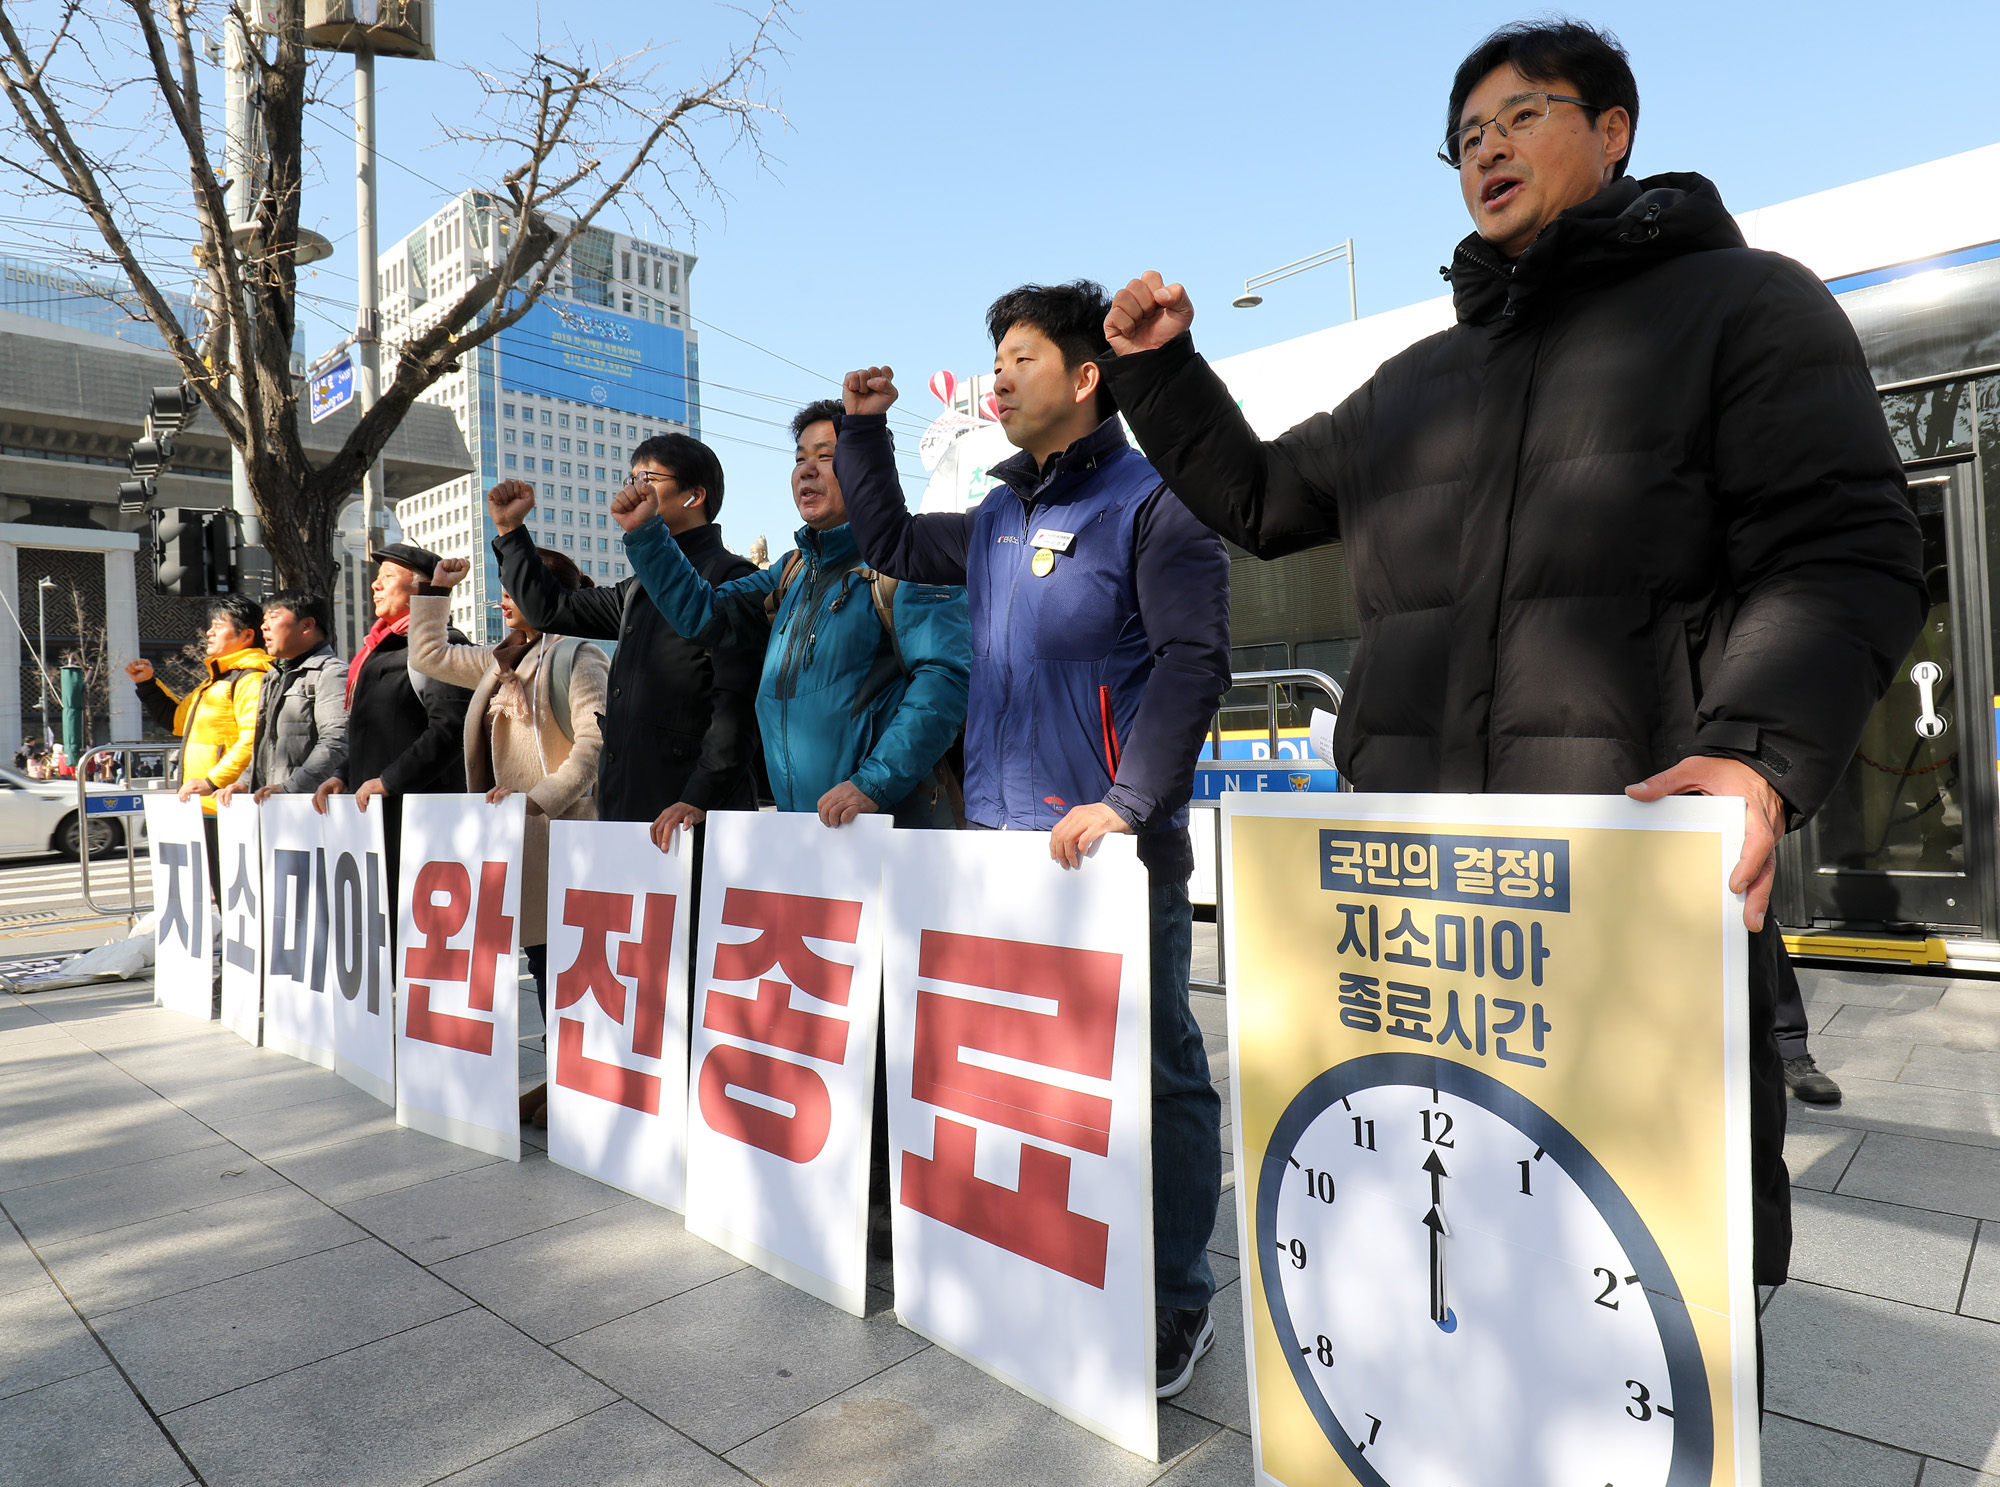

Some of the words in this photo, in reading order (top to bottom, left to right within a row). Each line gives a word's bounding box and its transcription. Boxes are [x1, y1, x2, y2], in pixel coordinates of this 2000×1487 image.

[631, 240, 658, 256] 외교부
[552, 331, 572, 342] 2019
[1330, 840, 1439, 891] 국민의
[1453, 847, 1555, 899] 결정!
[158, 841, 203, 958] 지
[226, 842, 256, 974] 소
[270, 847, 329, 993] 미
[334, 851, 386, 1016] 아
[404, 860, 514, 1056] 완
[1336, 903, 1551, 987] 지소미아
[555, 888, 677, 1116] 전
[698, 887, 863, 1164] 종
[1338, 971, 1552, 1069] 종료시간
[900, 929, 1123, 1290] 료
[1351, 1115, 1377, 1152] 11
[1419, 1109, 1455, 1149] 12
[1304, 1168, 1336, 1204] 10
[1516, 1158, 1535, 1197] 1
[1289, 1238, 1307, 1270] 9
[1593, 1266, 1620, 1311] 2
[1316, 1334, 1334, 1367] 8
[1624, 1379, 1653, 1423] 3
[1364, 1412, 1382, 1446] 7
